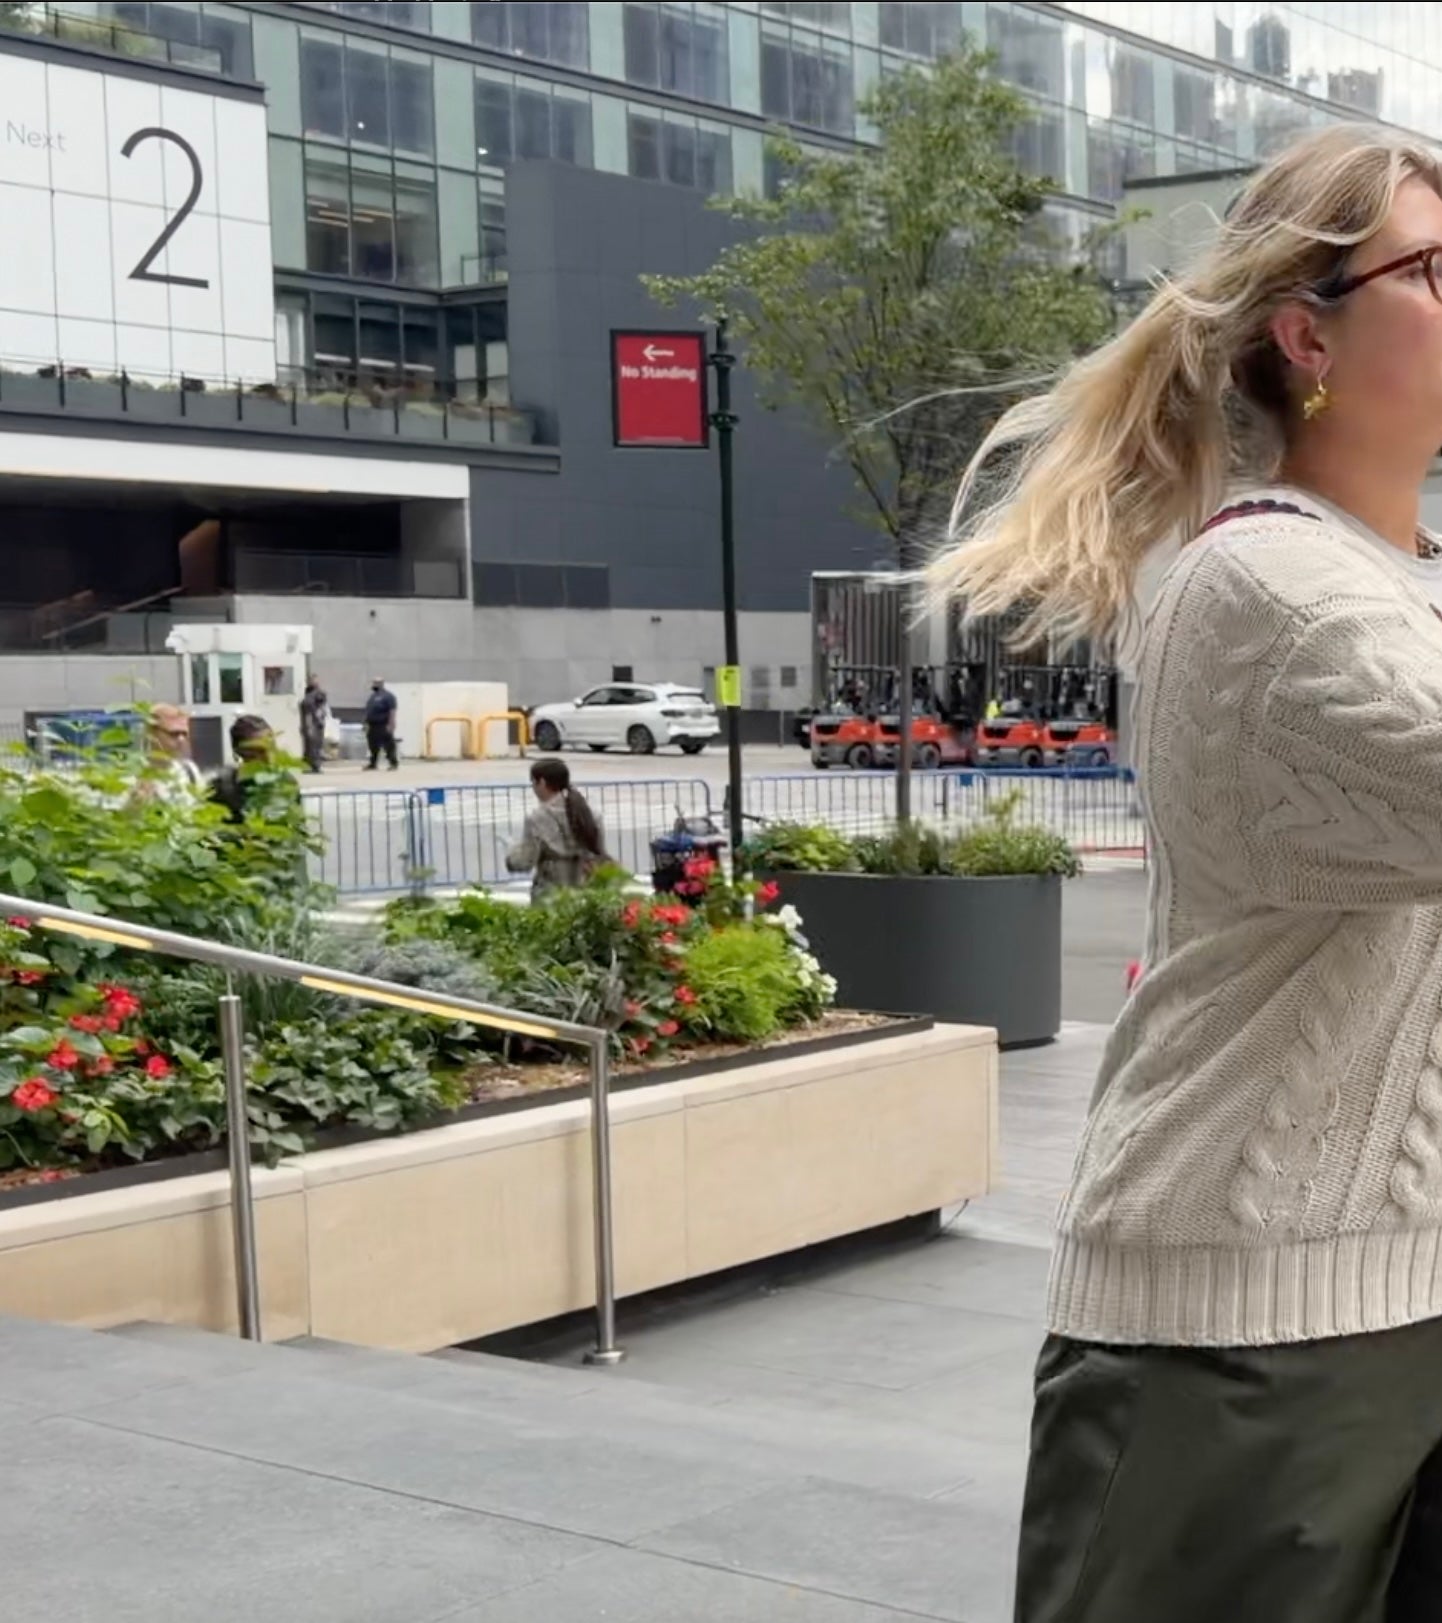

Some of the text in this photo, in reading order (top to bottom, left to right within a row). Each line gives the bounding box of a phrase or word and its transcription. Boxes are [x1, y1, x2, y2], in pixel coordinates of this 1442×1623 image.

[6, 120, 66, 152] Next
[120, 126, 209, 289] 2
[621, 365, 697, 383] No Standing
